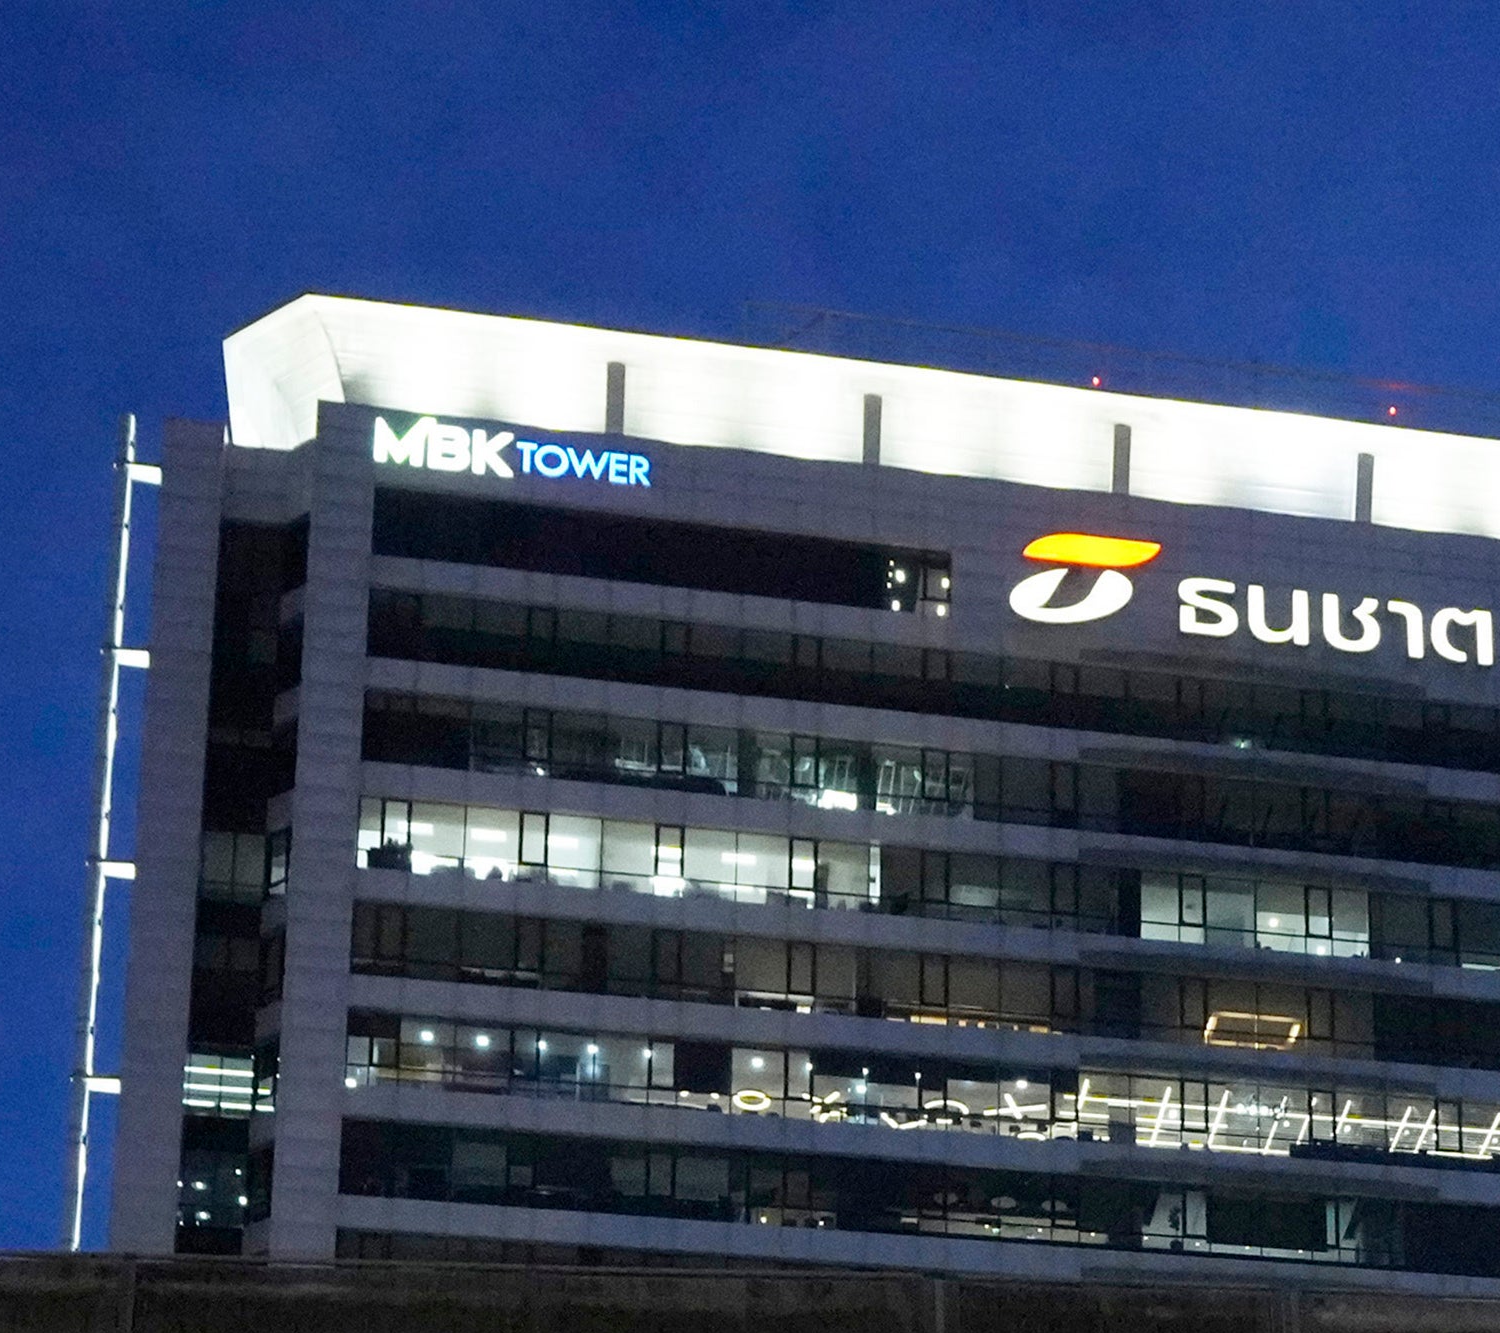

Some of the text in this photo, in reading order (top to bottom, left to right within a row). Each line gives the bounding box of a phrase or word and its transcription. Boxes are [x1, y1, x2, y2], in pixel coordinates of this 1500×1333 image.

[373, 416, 651, 486] MBK TOWER
[1177, 576, 1495, 666] ธนชาต
